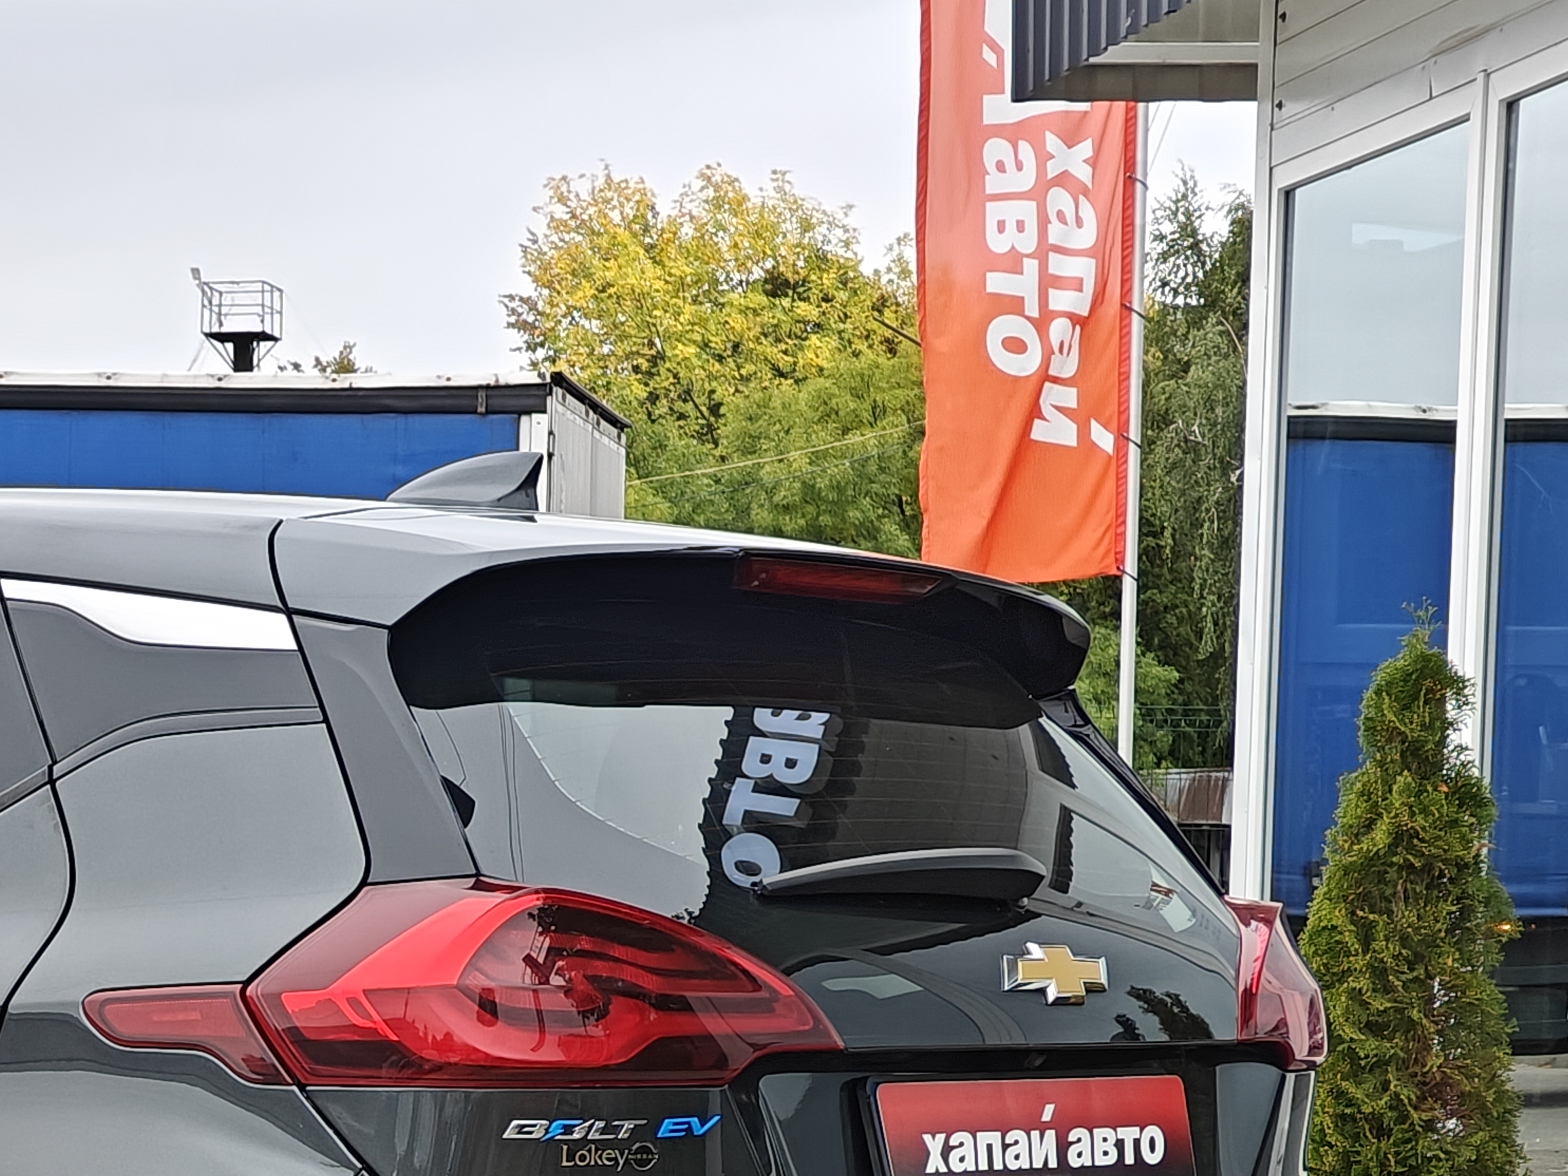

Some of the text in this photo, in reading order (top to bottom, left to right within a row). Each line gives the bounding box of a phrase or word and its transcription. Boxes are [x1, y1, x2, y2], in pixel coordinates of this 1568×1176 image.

[982, 137, 1042, 377] авто
[1030, 130, 1114, 455] хапай
[501, 1113, 722, 1142] BOLT EV
[921, 1103, 1166, 1174] хапай авто
[560, 1143, 629, 1172] Lokey
[628, 1152, 659, 1160] NISSAN
